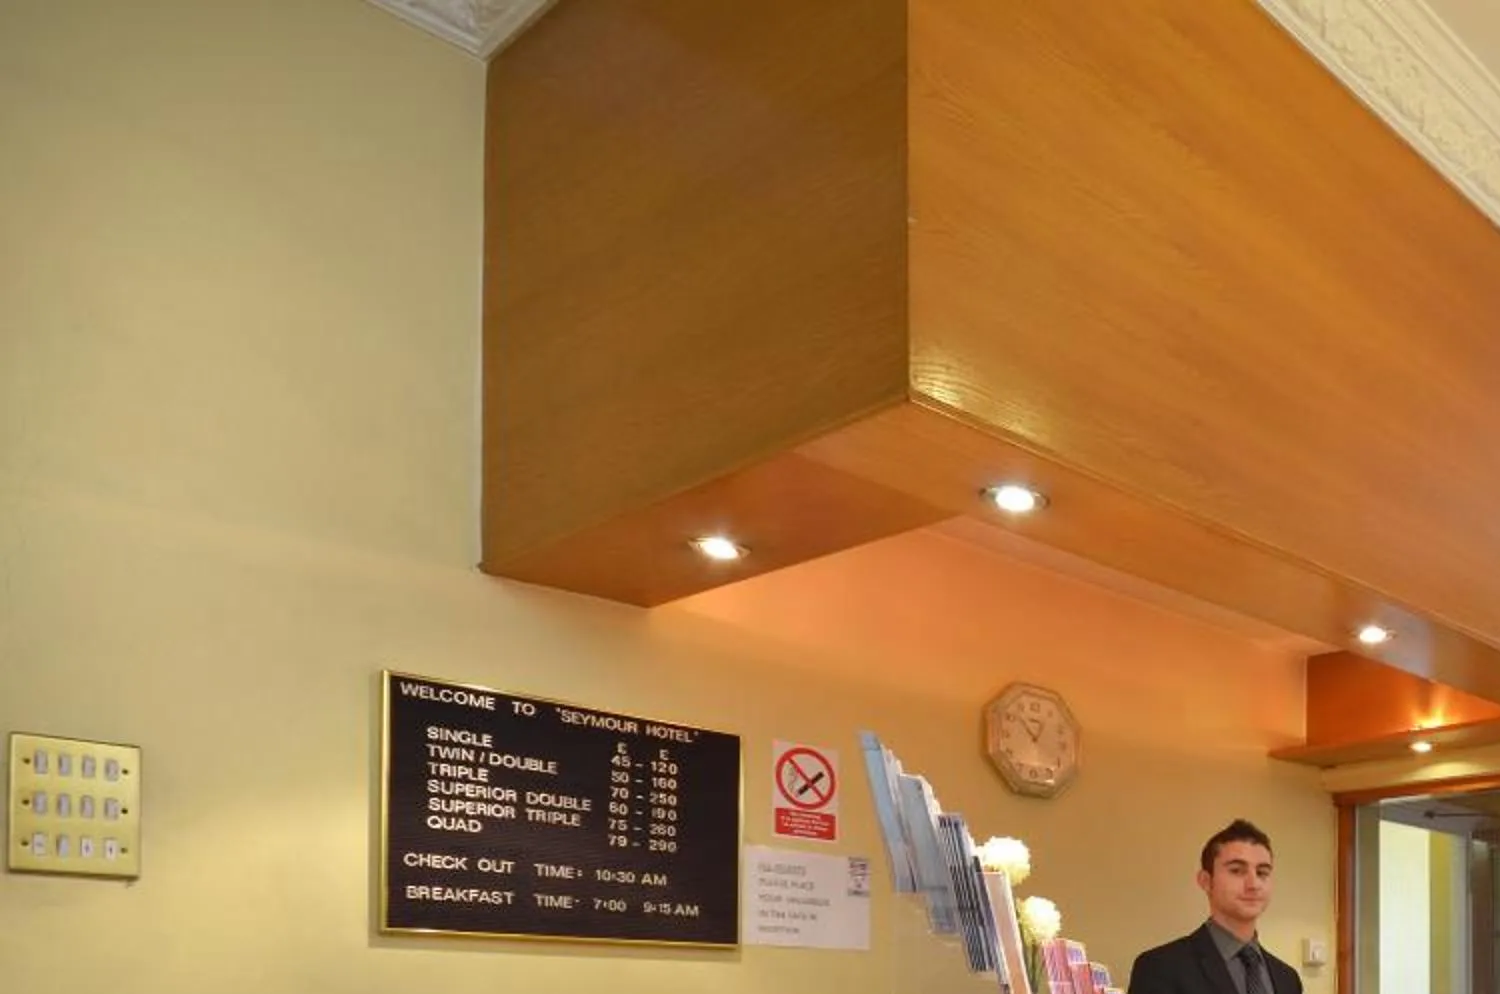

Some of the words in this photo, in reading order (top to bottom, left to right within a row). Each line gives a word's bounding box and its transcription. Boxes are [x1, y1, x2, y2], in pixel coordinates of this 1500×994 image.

[400, 682, 496, 711] WELCOME
[511, 701, 536, 716] TO
[426, 725, 493, 748] SINGLE
[611, 755, 631, 769] 45
[650, 761, 678, 775] 120
[426, 743, 475, 762] TWIN
[489, 752, 558, 774] DOUBLE
[427, 761, 489, 782] TRIPLE
[609, 786, 629, 799] 70
[427, 779, 518, 803] SUPERIOR
[526, 791, 592, 812] DOUBLE
[427, 815, 483, 833] QUAD
[428, 797, 516, 819] SUPERIOR
[526, 808, 581, 827] TRIPLE
[608, 818, 628, 831] 75
[403, 852, 468, 870] CHECK
[477, 857, 516, 873] OUT
[641, 872, 667, 886] AM
[405, 885, 515, 905] BREAKFAST
[673, 903, 699, 918] AM
